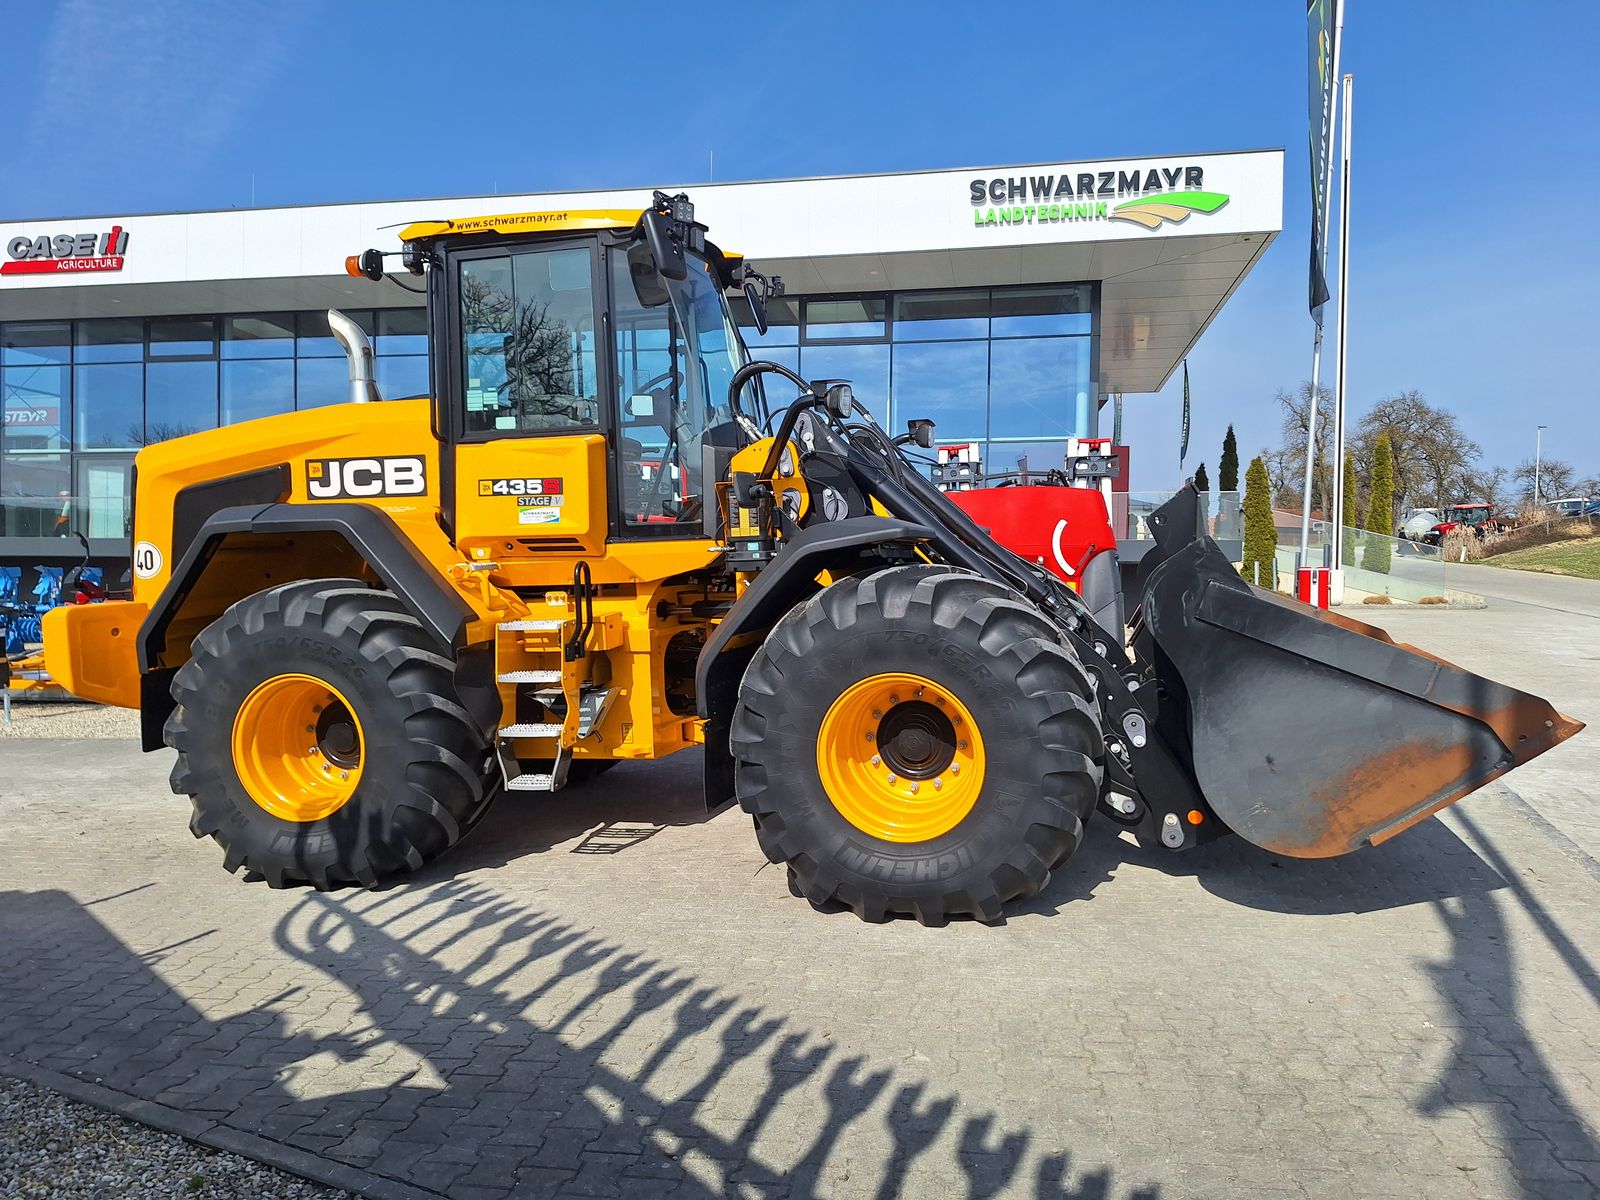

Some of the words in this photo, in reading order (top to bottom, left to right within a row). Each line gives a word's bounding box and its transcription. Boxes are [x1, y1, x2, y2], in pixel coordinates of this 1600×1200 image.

[970, 166, 1204, 202] SCHWARZMAYR
[457, 212, 568, 230] www.schwarzmayr.at
[974, 201, 1107, 226] LANDTECHNIK
[7, 233, 97, 260] CASE
[57, 259, 118, 270] AGRICULTURE
[5, 410, 49, 424] STEYR
[309, 458, 425, 497] JCB
[493, 479, 560, 495] 435S
[518, 497, 550, 506] STAGE
[136, 550, 154, 570] 40
